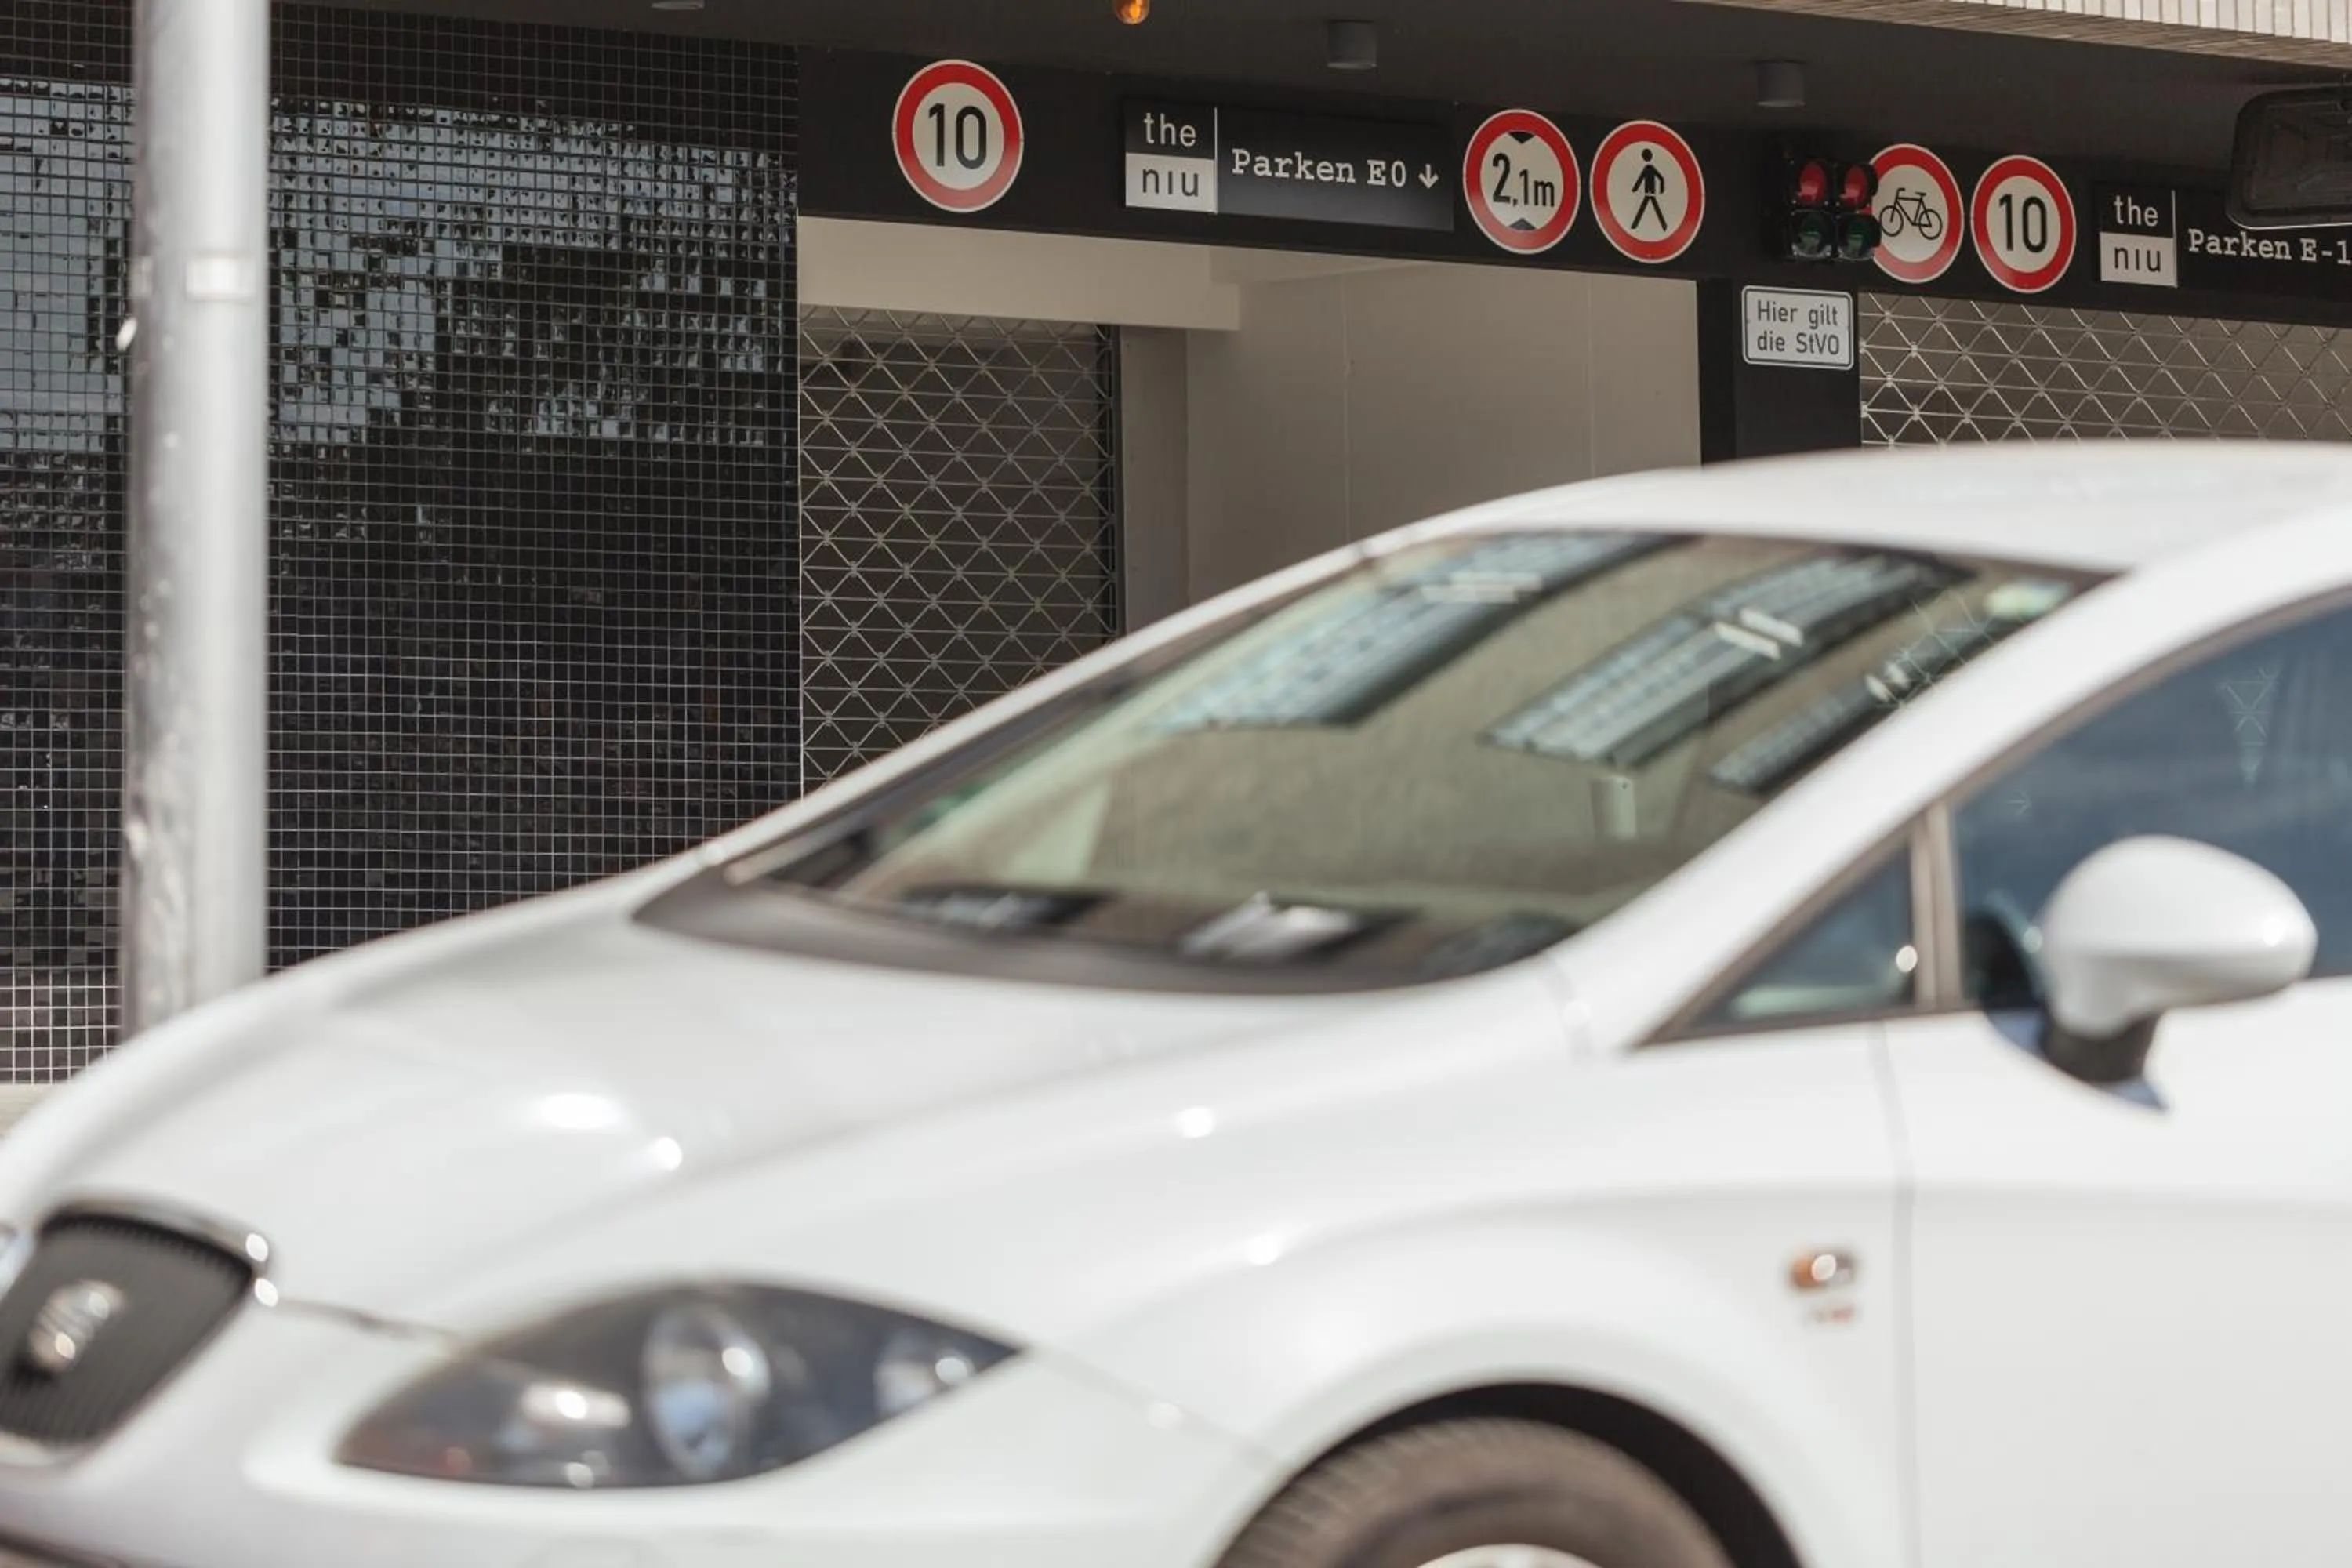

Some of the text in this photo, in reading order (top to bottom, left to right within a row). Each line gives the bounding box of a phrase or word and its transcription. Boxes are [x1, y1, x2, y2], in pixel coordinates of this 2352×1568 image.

[928, 103, 987, 169] 10
[1143, 112, 1197, 147] the
[1232, 148, 1356, 184] Parken
[1998, 194, 2047, 252] 10
[2114, 195, 2158, 227] the
[2187, 228, 2292, 261] Parken
[1757, 299, 1838, 327] Hier gilt
[1757, 329, 1840, 355] die StVO
